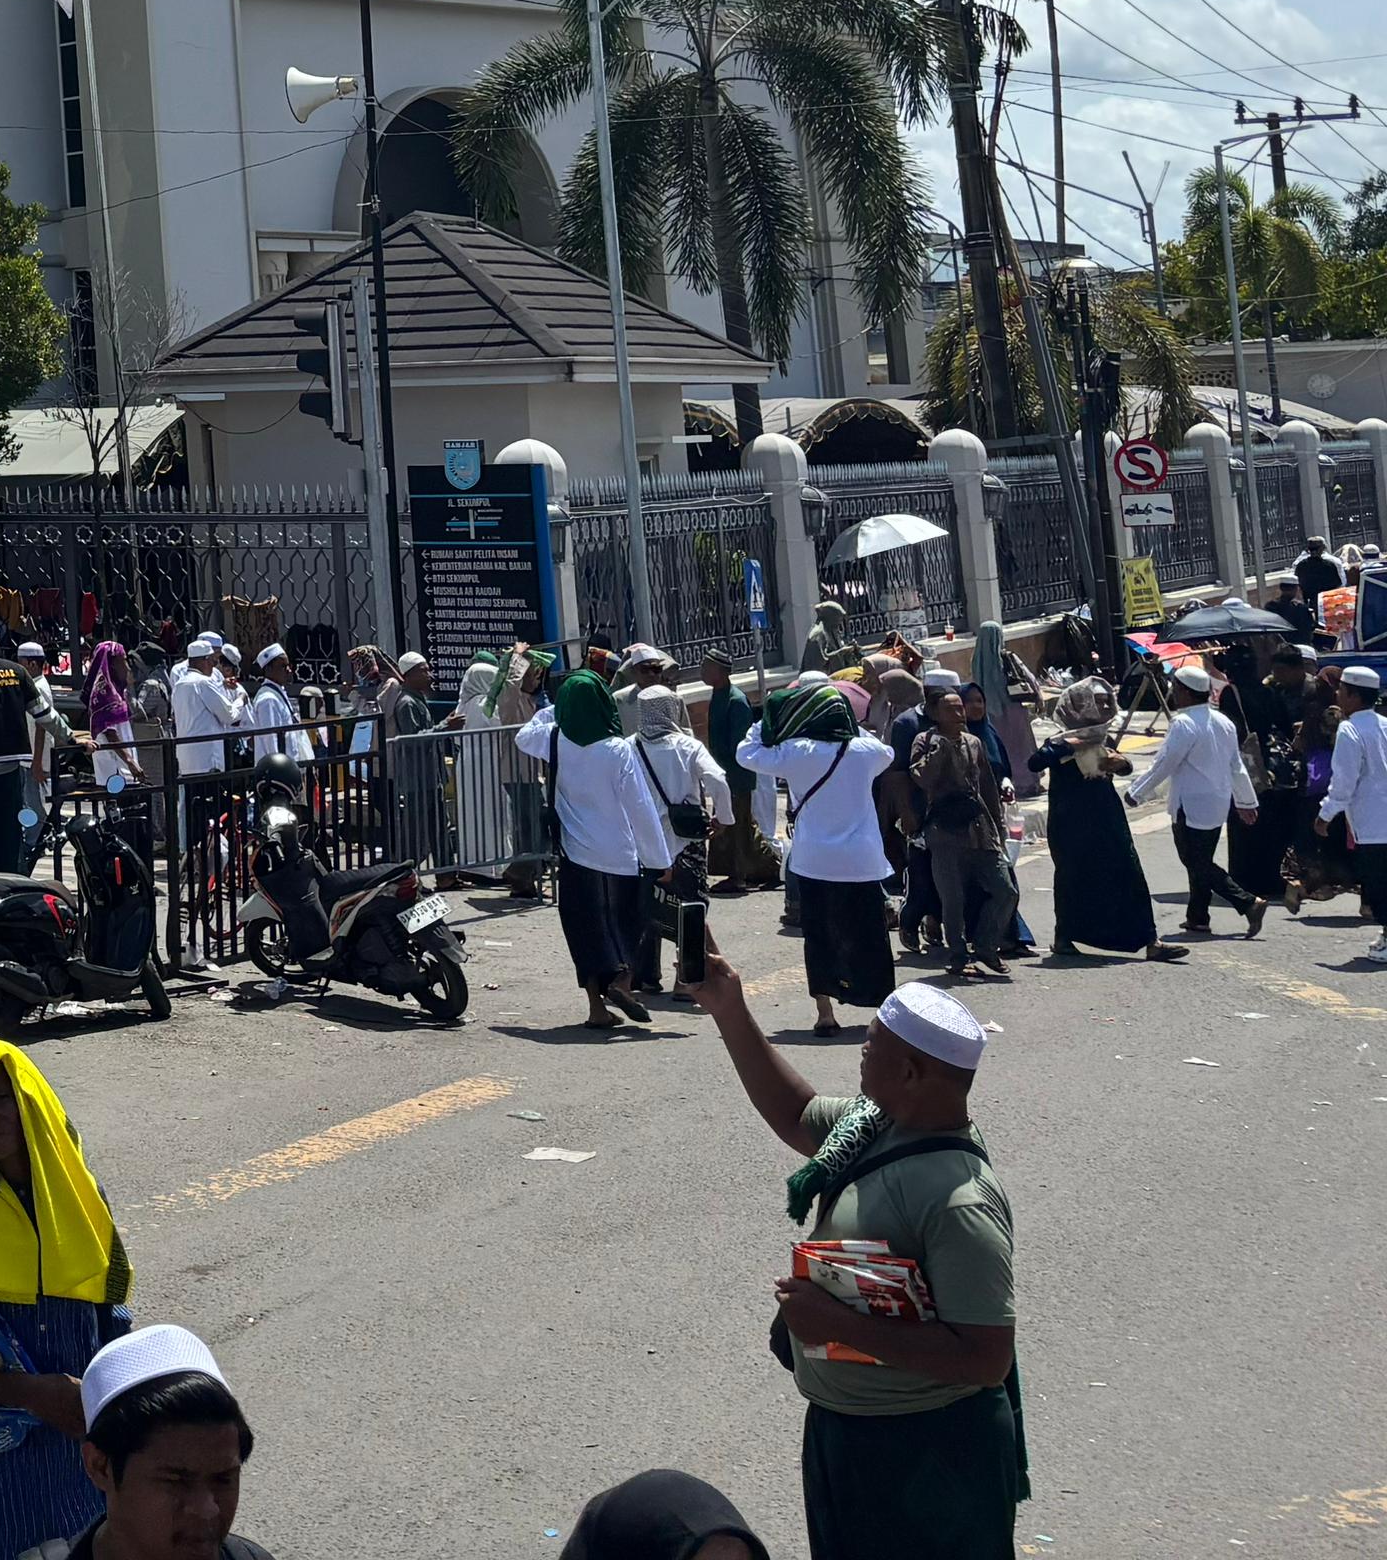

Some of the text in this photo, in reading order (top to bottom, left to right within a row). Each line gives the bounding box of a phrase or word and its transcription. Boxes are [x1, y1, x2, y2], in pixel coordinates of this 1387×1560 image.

[457, 498, 491, 507] SEKUMPUL
[430, 550, 453, 559] RUMAH
[455, 550, 472, 559] SAKIT
[474, 550, 495, 559] PELITA
[431, 562, 472, 570] KEMENTERIAN
[473, 562, 493, 570] AGAMA
[509, 562, 532, 570] BANJAR
[446, 574, 480, 583] SEKUMPUL
[475, 587, 501, 596] RAUDAH
[434, 598, 527, 608] KUBAH TUAN GURU SEKUMPUL
[434, 610, 456, 619] KANTOR
[457, 610, 488, 619] KECAMATAN
[435, 622, 452, 630] DEPO
[453, 622, 472, 631] ARSIP
[489, 623, 514, 632] BANJAR
[436, 633, 464, 643] STADION
[464, 634, 491, 643] DEMANG
[438, 658, 457, 667] DINAS
[439, 682, 458, 691] DINAS
